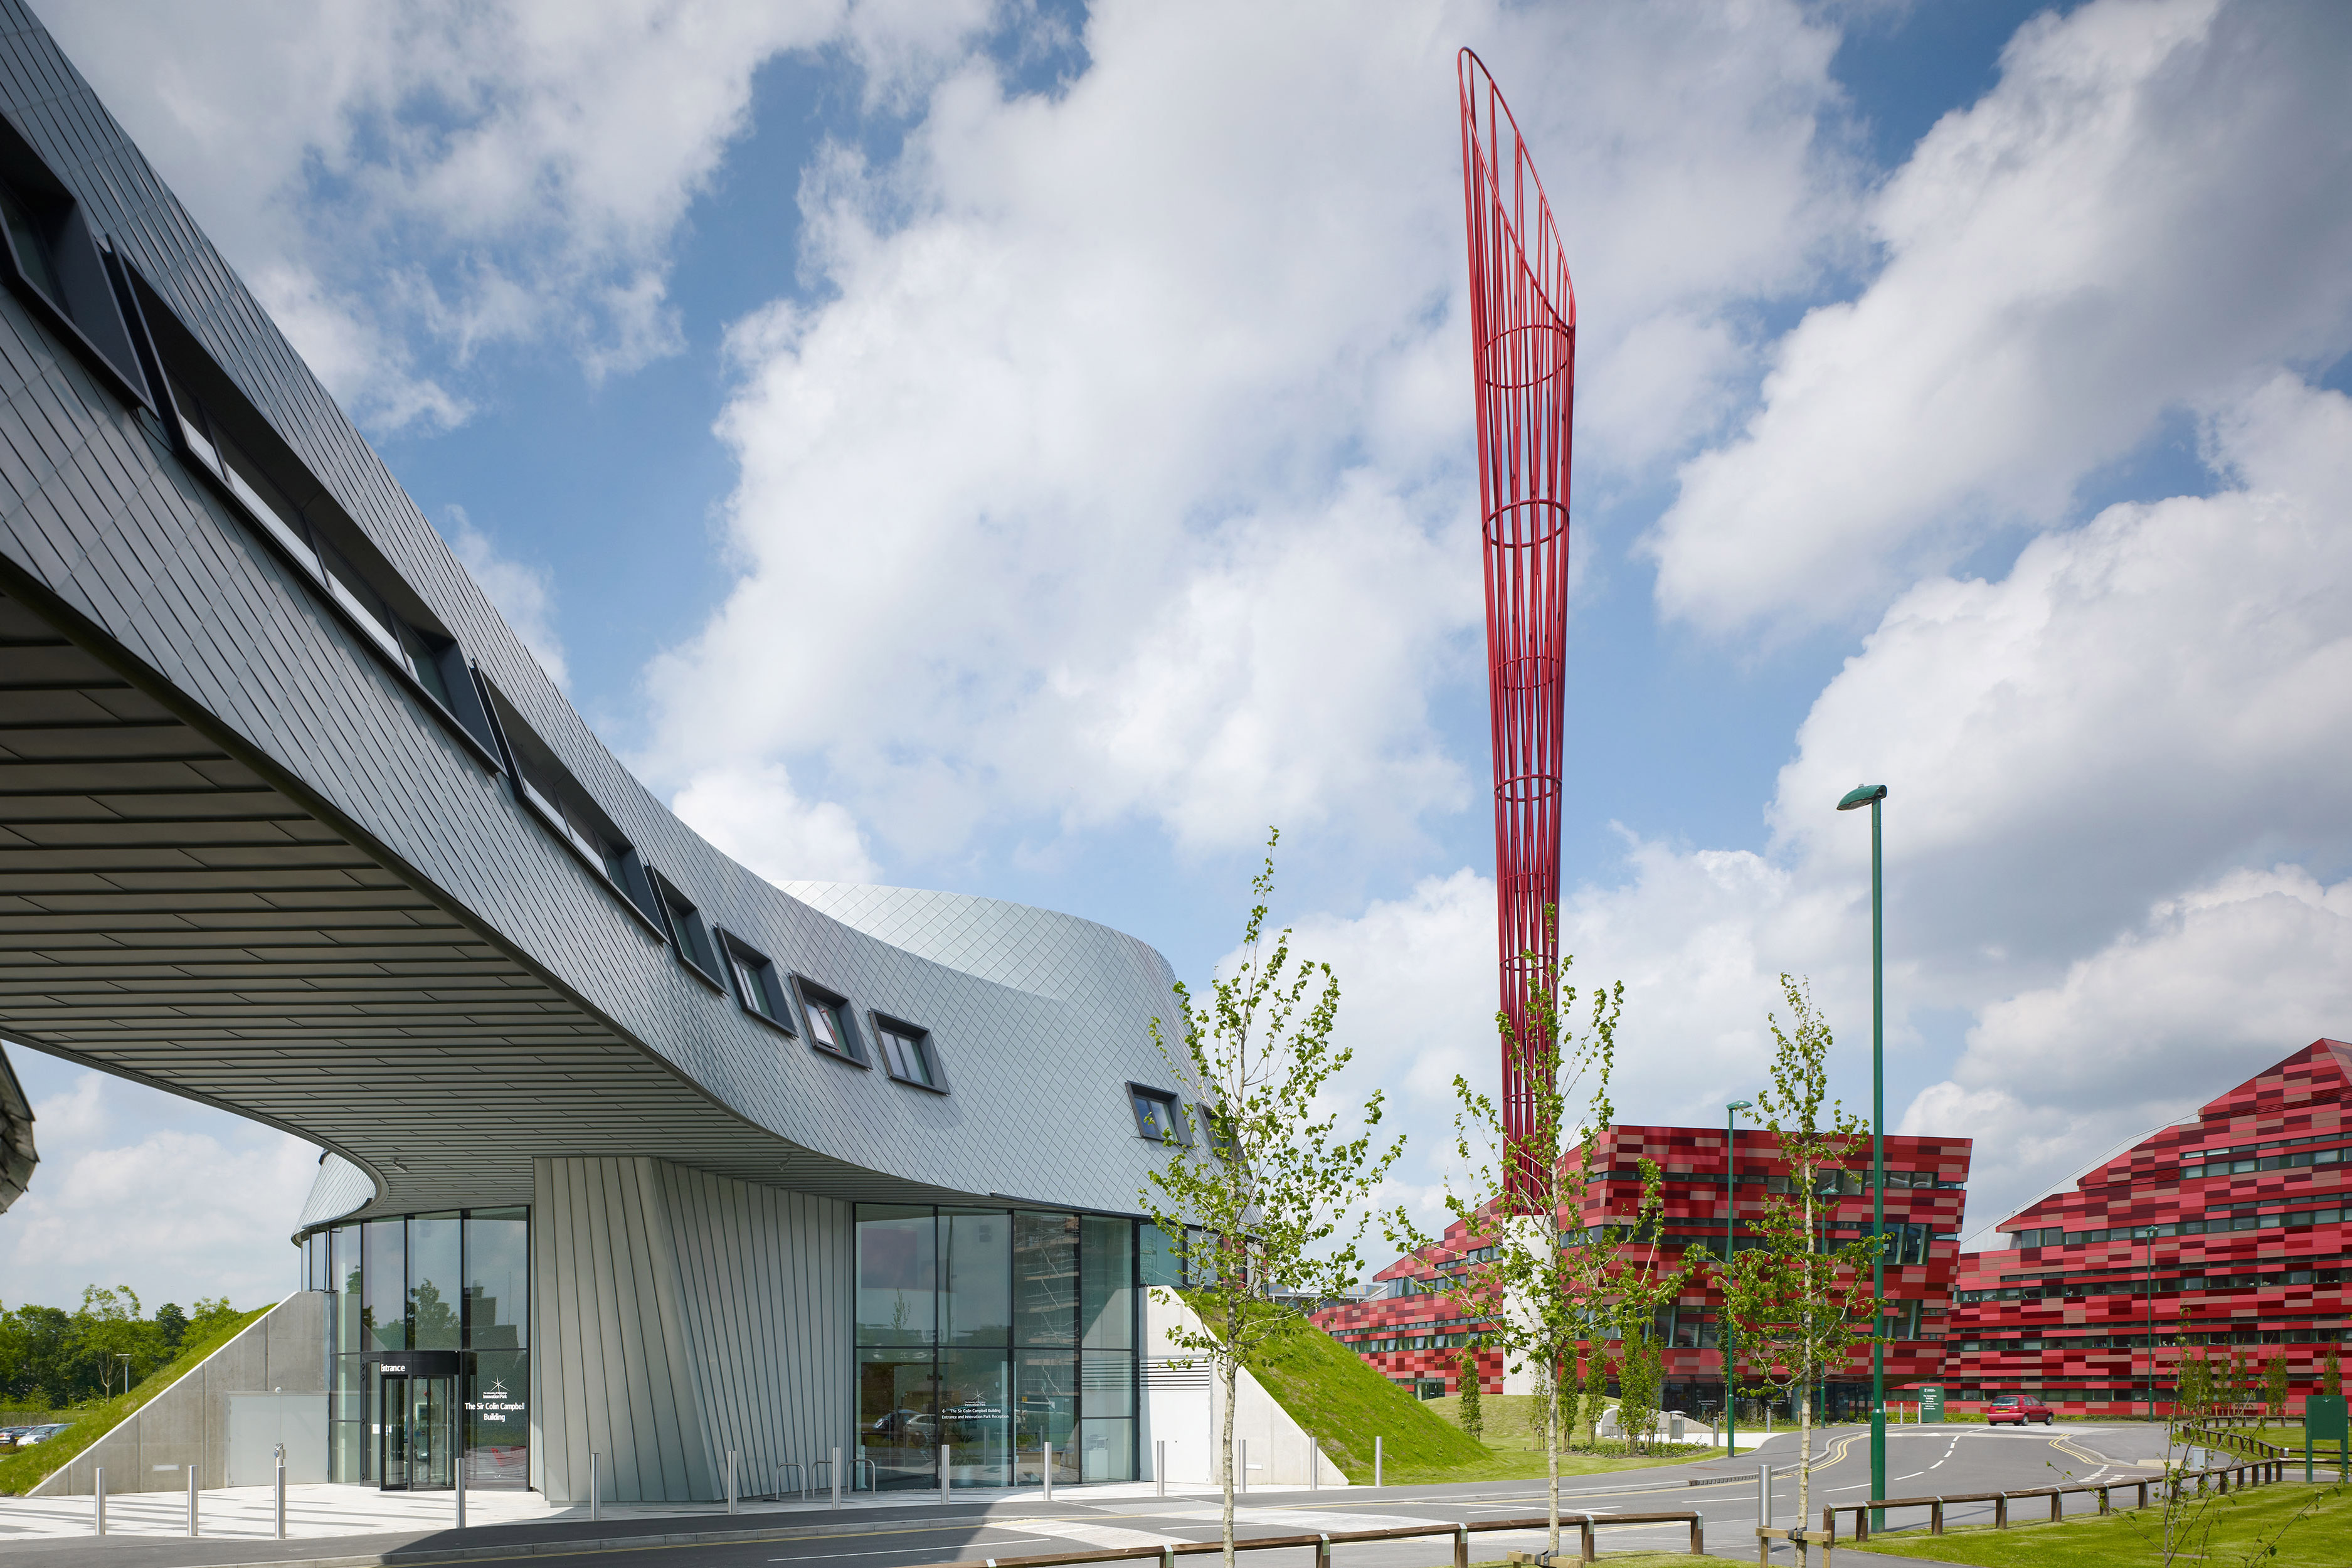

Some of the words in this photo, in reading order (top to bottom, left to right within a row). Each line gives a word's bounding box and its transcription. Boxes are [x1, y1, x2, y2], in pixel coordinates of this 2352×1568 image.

[381, 1364, 406, 1372] Entrance
[500, 1402, 525, 1412] Campbell
[484, 1413, 506, 1422] Building
